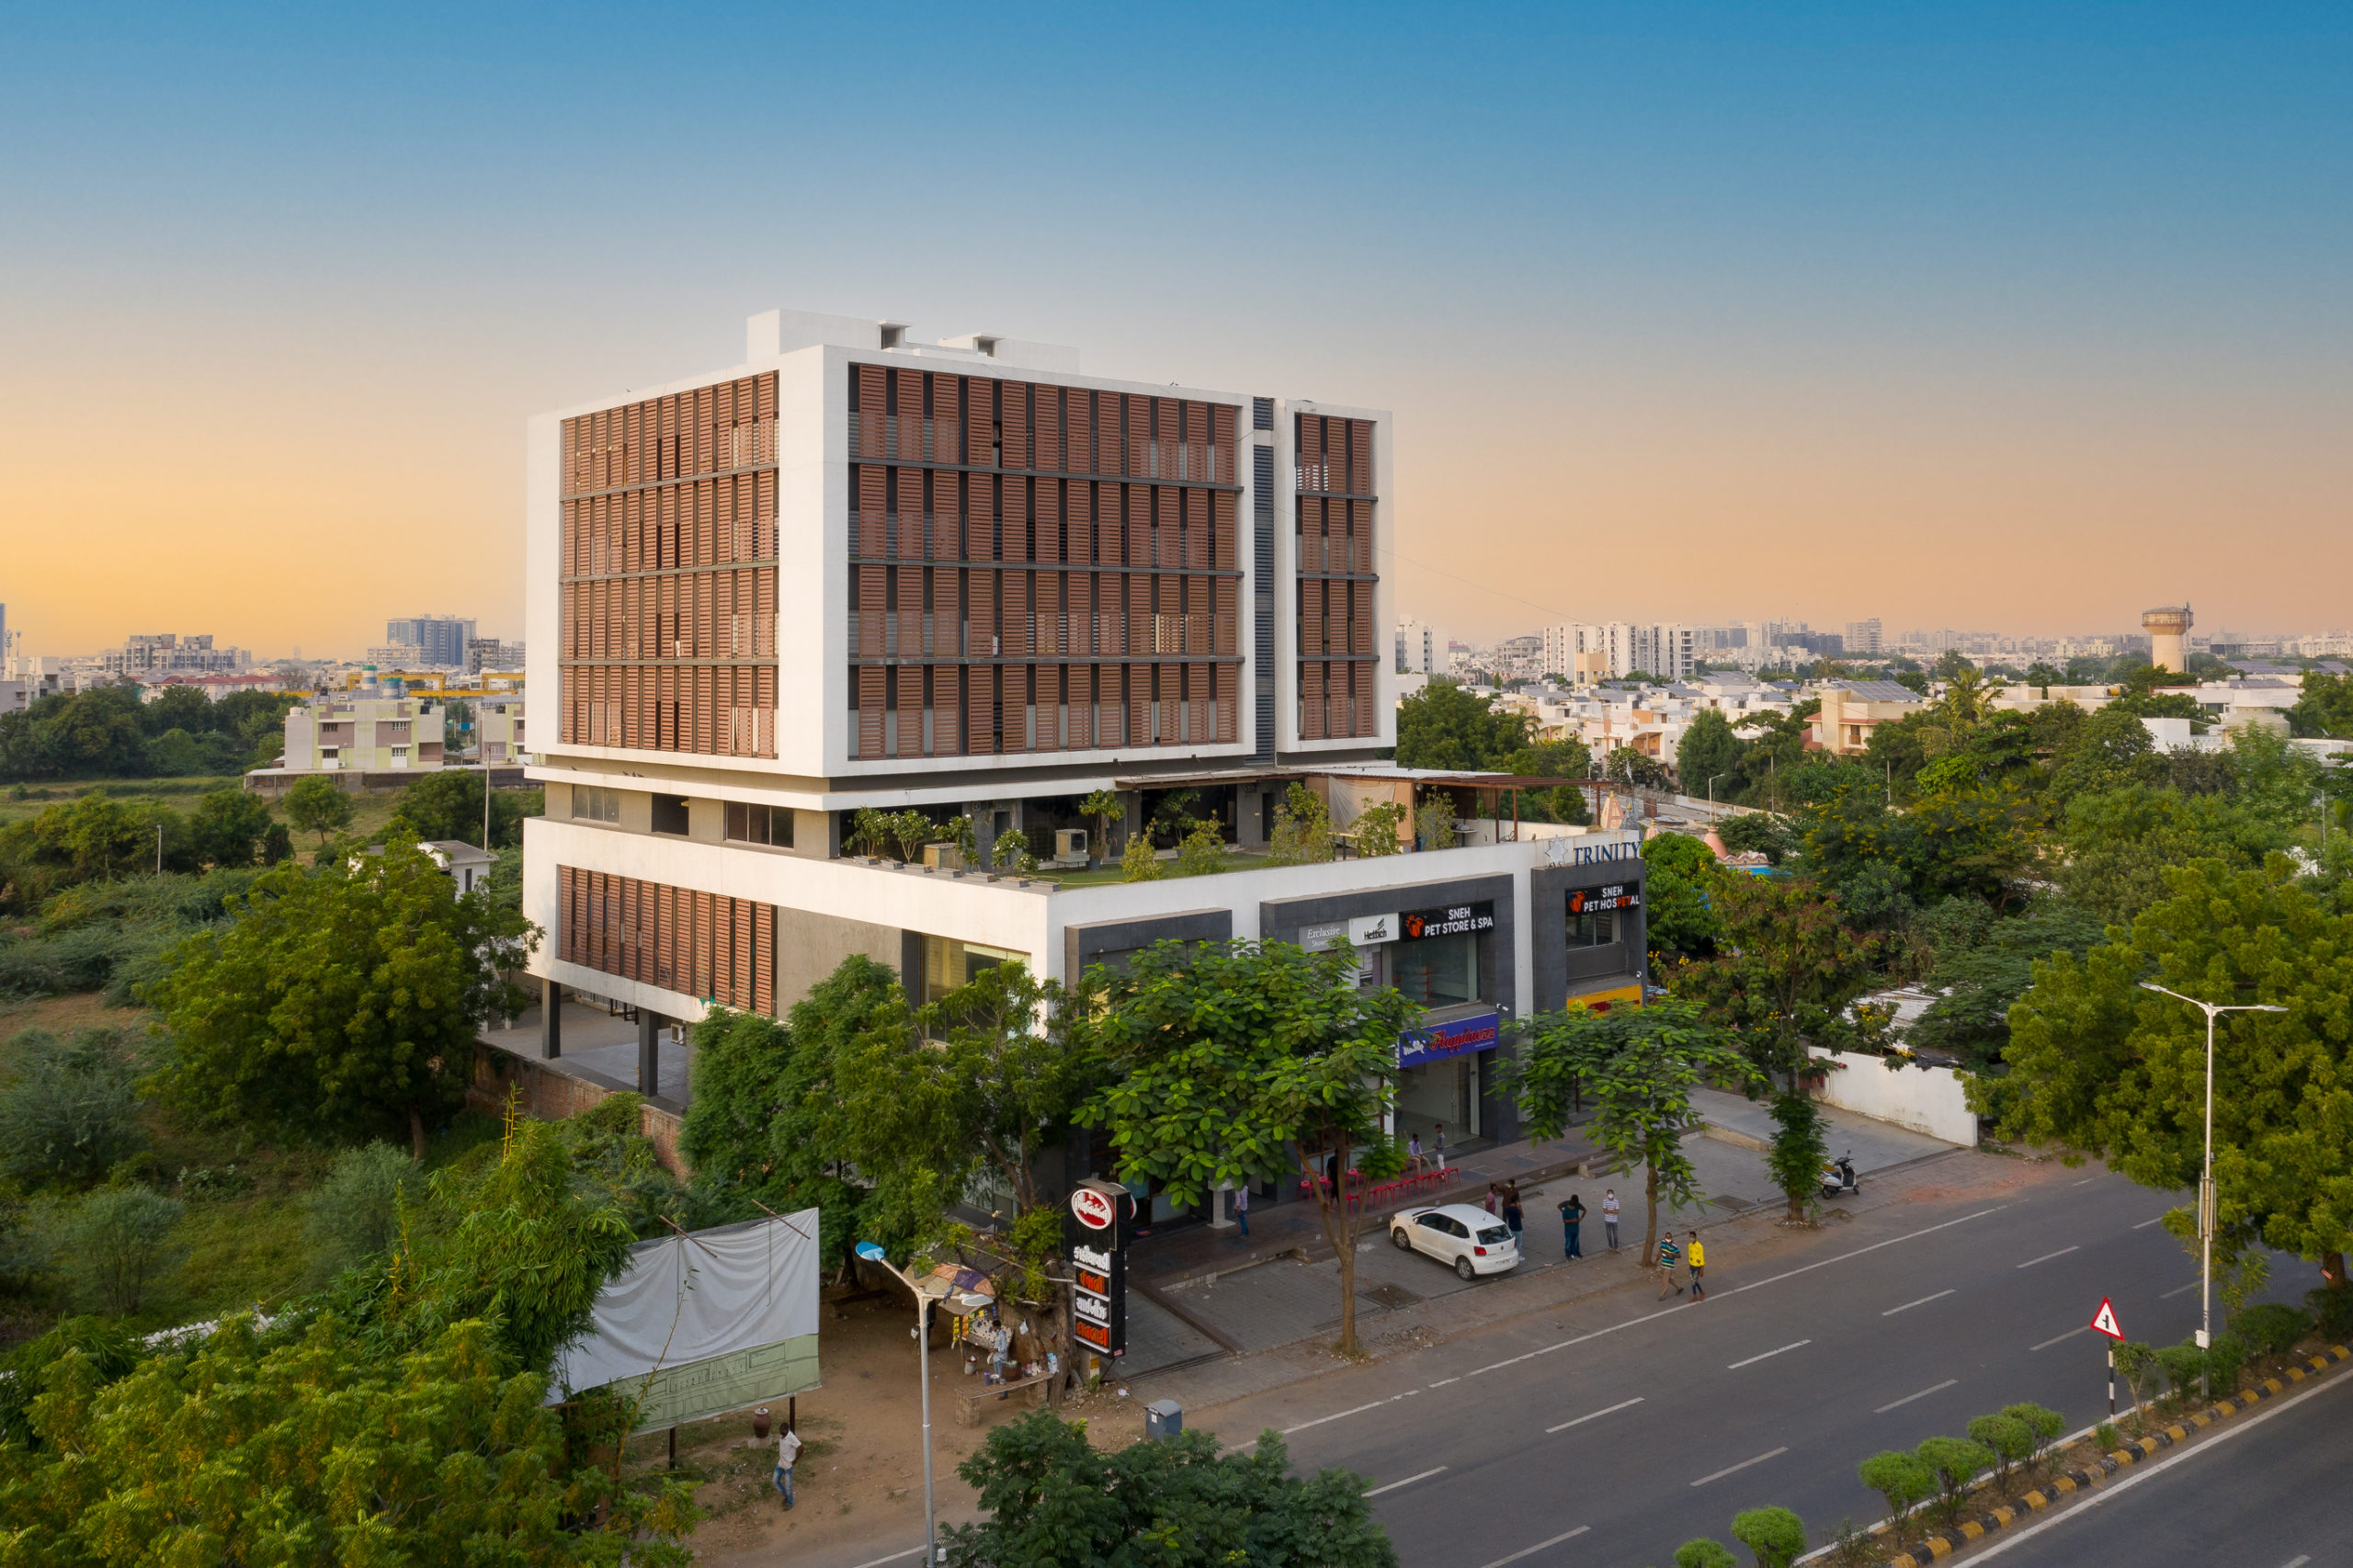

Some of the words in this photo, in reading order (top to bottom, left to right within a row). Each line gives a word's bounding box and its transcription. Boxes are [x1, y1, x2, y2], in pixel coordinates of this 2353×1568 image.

[1574, 840, 1643, 867] TRINITY
[1602, 885, 1623, 898] SNEH
[1584, 901, 1598, 913] PET
[1600, 895, 1641, 910] HOSPETAL
[1449, 906, 1471, 920] SNEH
[1307, 926, 1340, 939] Exclusive
[1363, 927, 1388, 940] Hettich
[1425, 924, 1440, 937] PET
[1442, 919, 1470, 935] STORE
[1471, 918, 1476, 929] &
[1478, 916, 1494, 929] SPA
